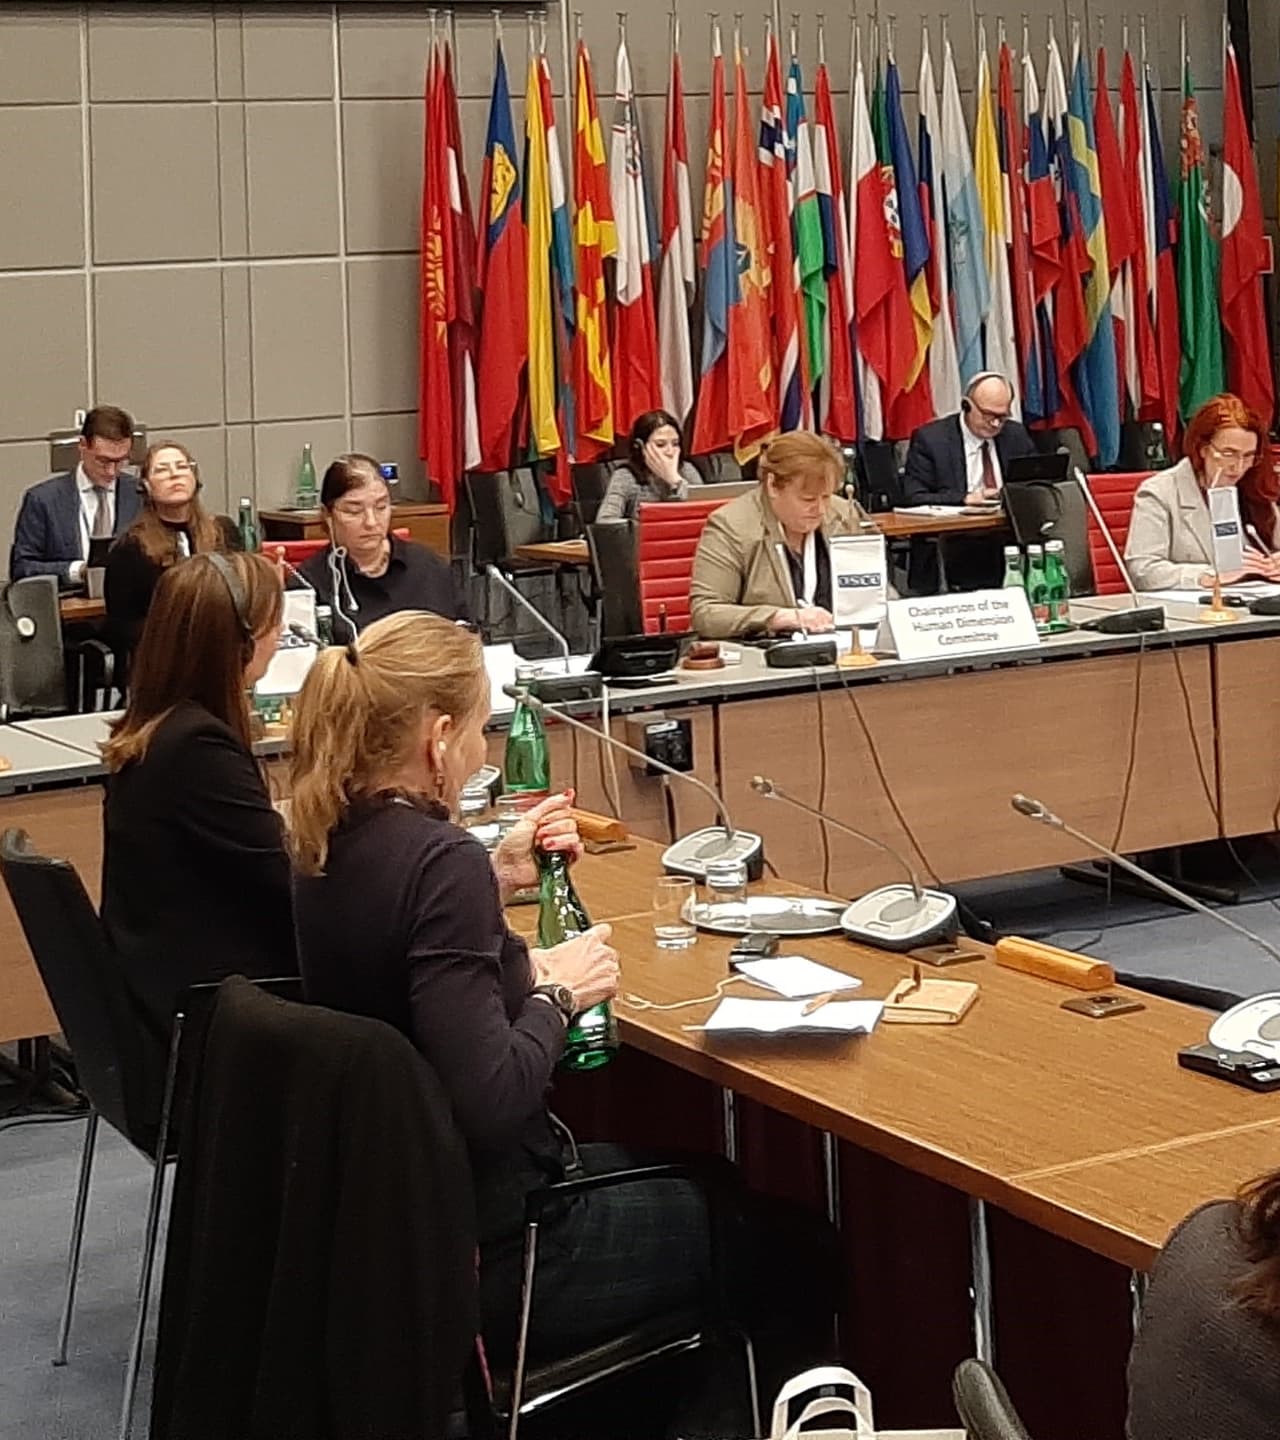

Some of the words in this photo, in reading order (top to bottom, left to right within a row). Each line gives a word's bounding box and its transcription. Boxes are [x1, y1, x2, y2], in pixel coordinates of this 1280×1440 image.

[908, 602, 974, 618] Chairperson
[913, 620, 953, 631] Human
[956, 614, 1015, 629] Dimension
